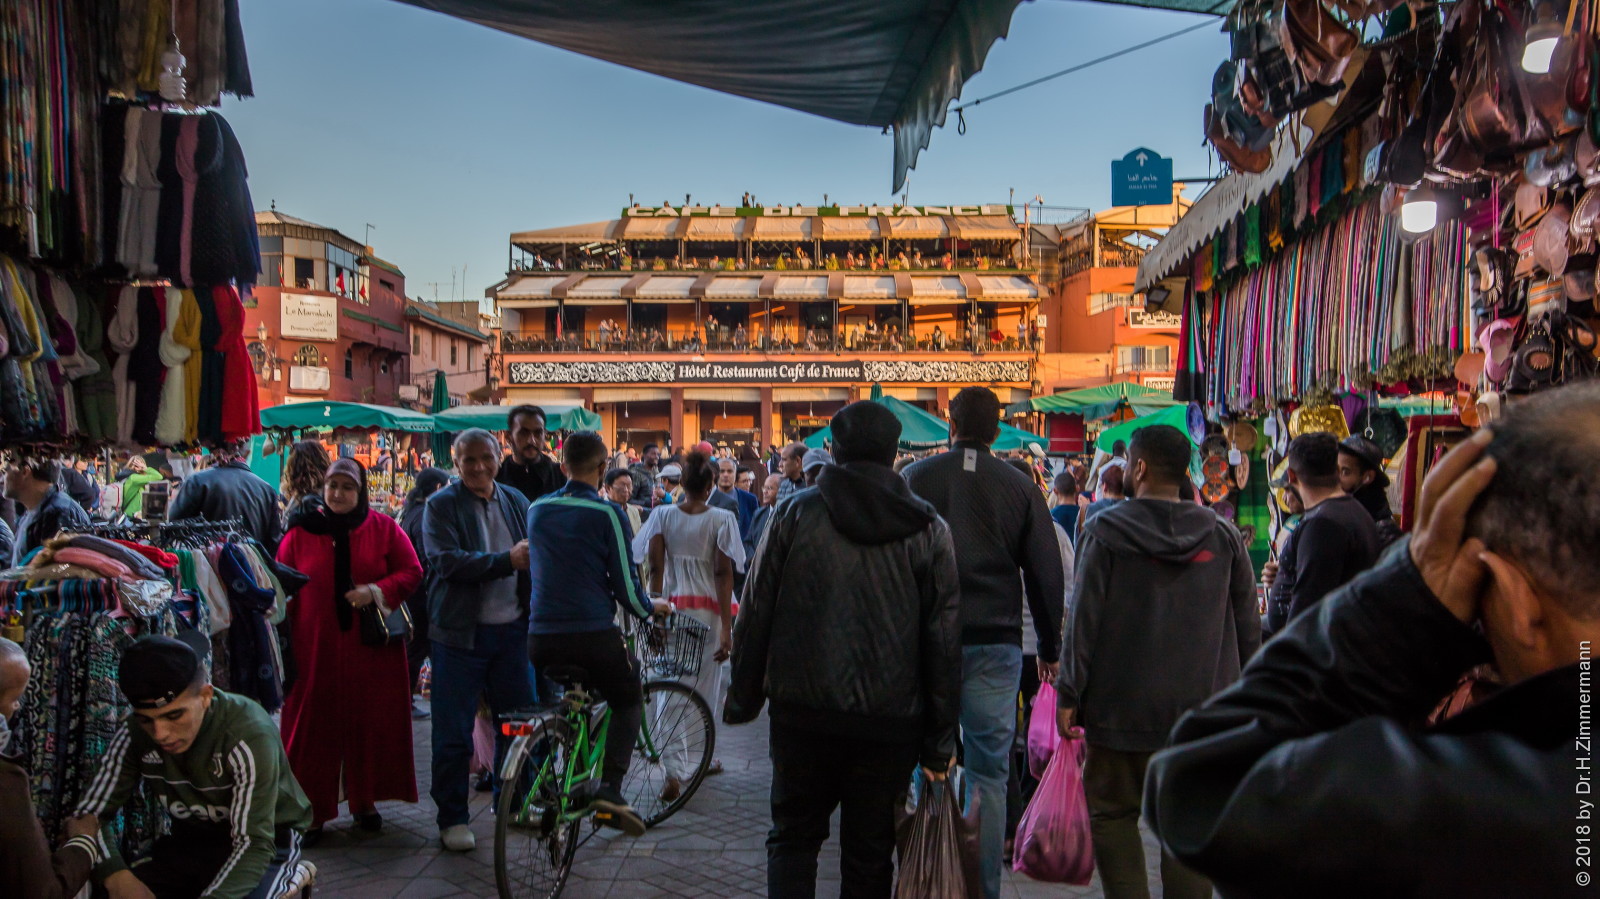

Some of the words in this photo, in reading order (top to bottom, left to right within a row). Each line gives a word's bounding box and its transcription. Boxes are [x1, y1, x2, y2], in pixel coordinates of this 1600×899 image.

[763, 207, 818, 216] DE
[839, 205, 1008, 216] FRANCE
[285, 306, 296, 315] Le
[679, 363, 711, 378] Hôtel
[713, 364, 778, 378] Restaurant
[779, 364, 805, 382] Café
[807, 363, 821, 378] de
[822, 364, 860, 378] France
